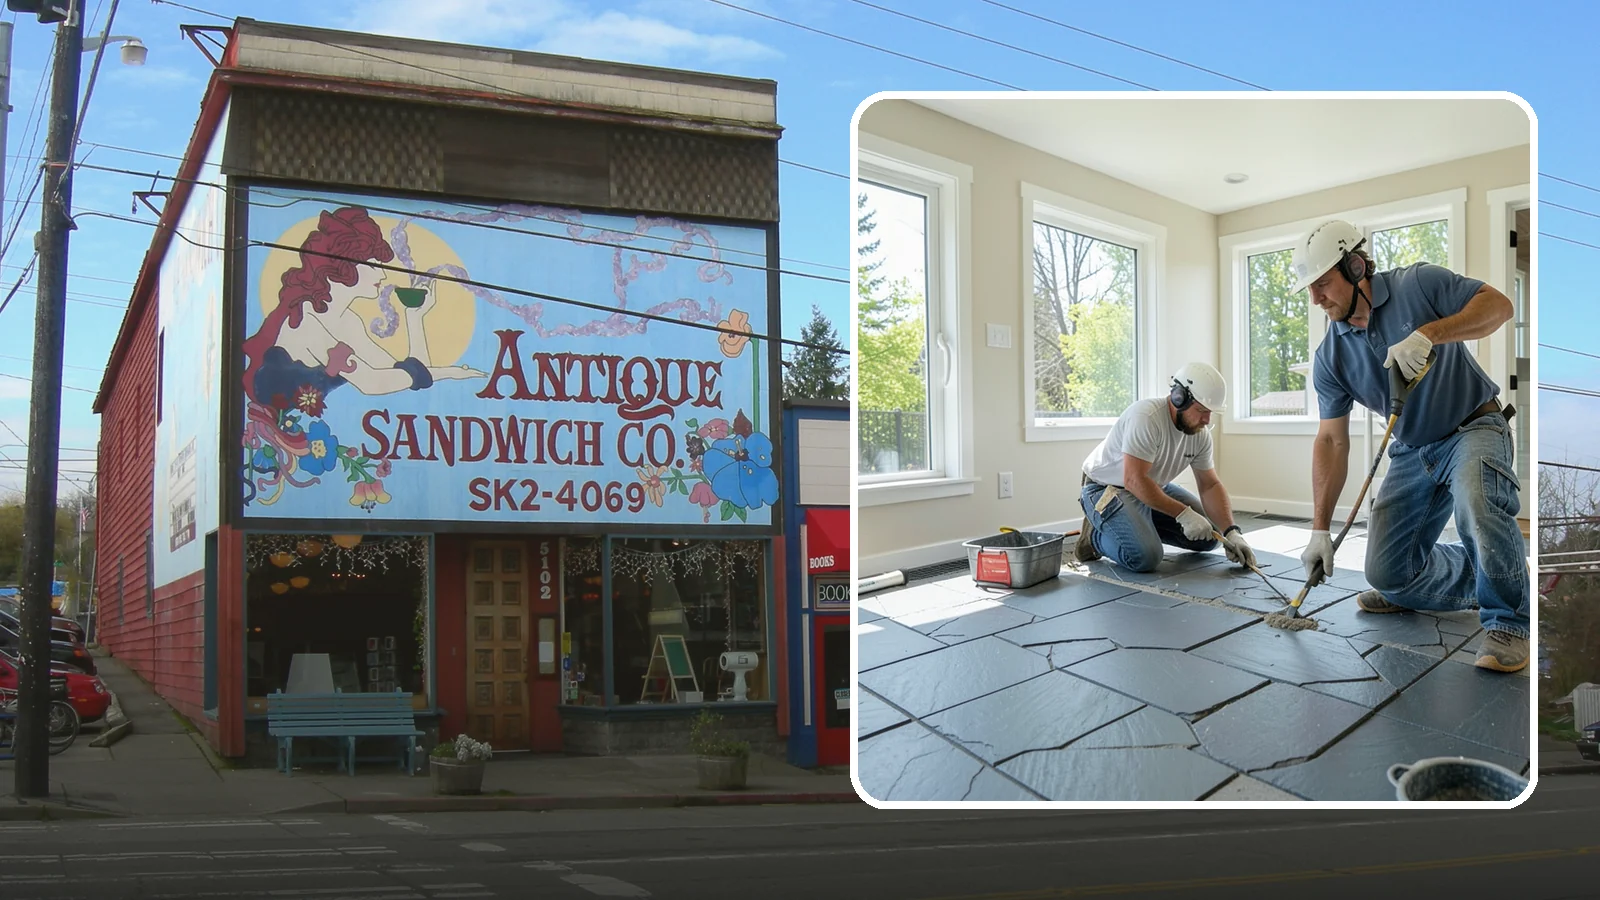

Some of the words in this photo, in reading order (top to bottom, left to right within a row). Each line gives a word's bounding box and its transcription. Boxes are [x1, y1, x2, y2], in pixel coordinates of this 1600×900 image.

[476, 329, 724, 420] ANTIQUE
[361, 408, 605, 467] SANDWICH
[616, 421, 686, 469] CO.
[468, 476, 646, 514] SK2-4069
[539, 541, 552, 600] 5102
[809, 555, 835, 569] BOOKS
